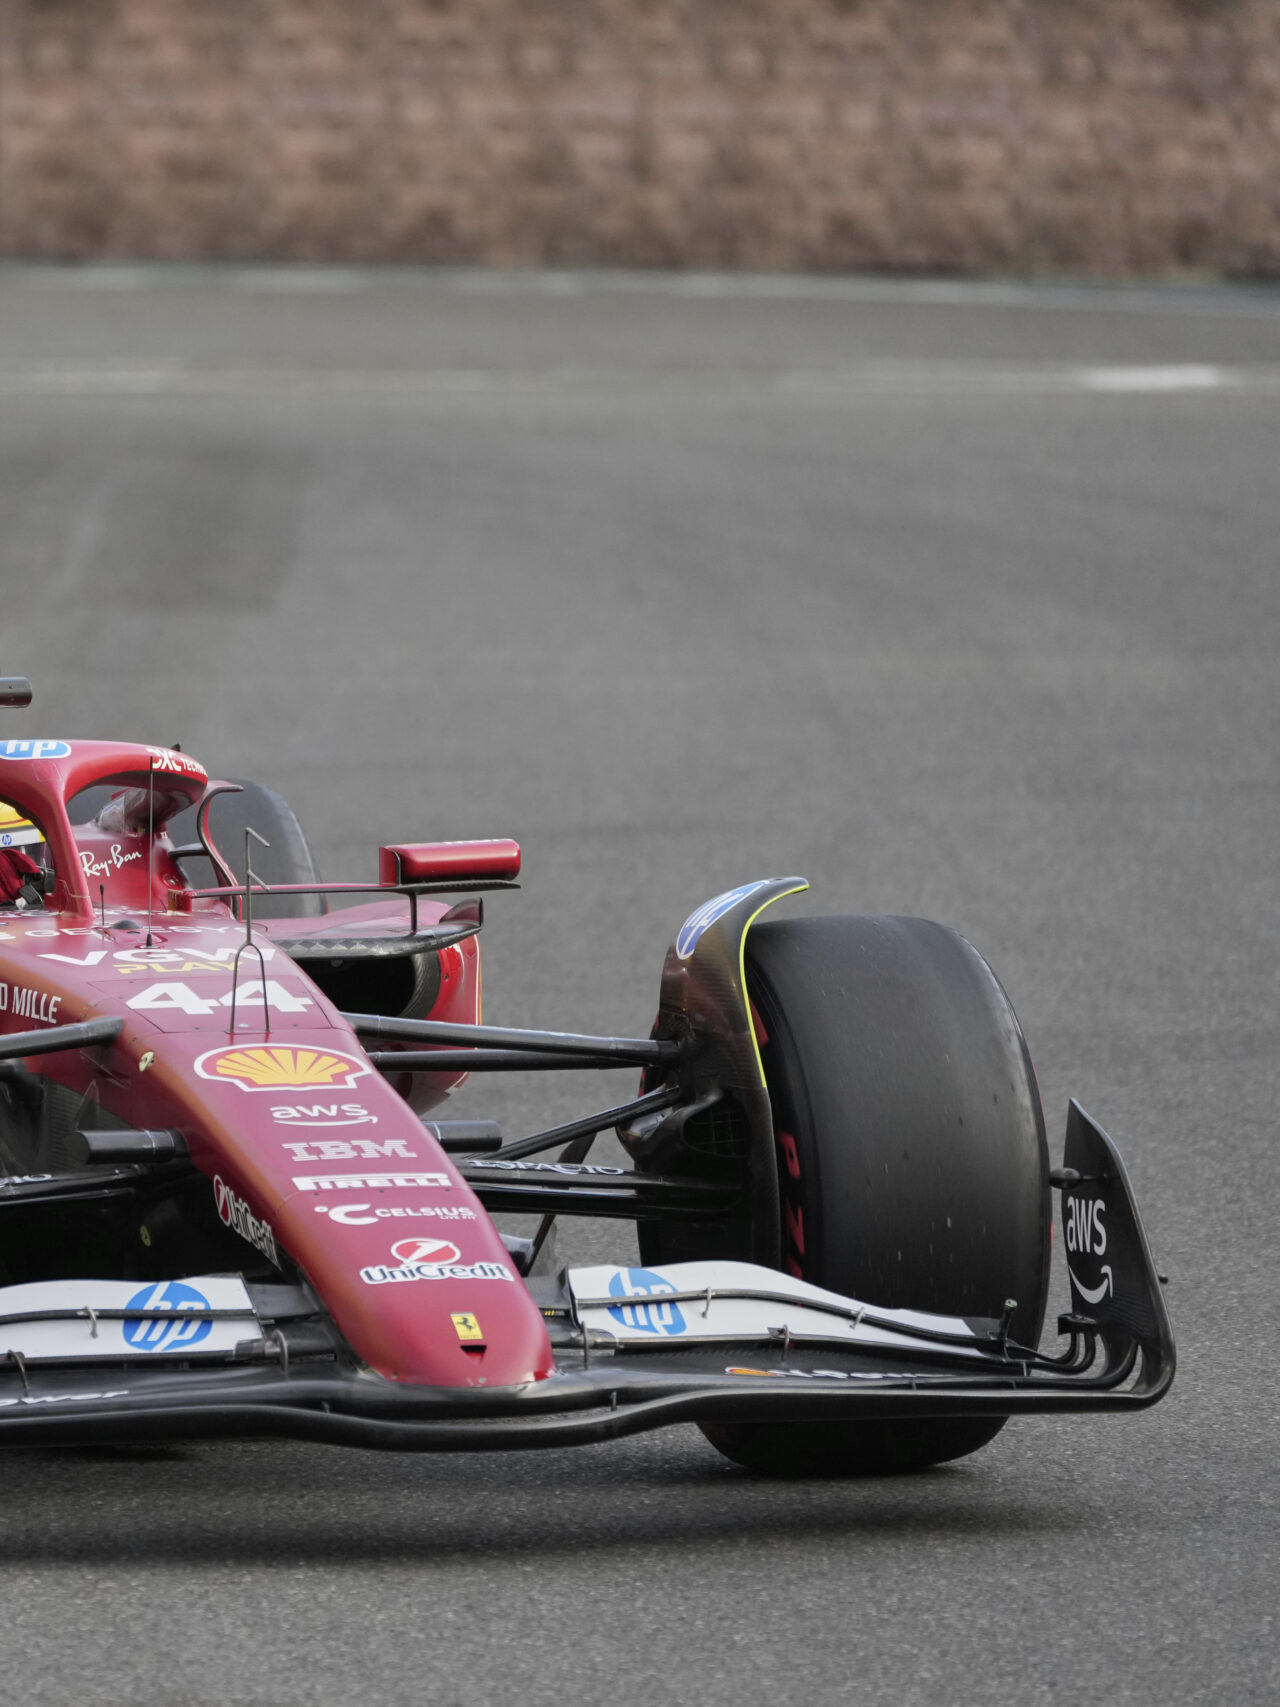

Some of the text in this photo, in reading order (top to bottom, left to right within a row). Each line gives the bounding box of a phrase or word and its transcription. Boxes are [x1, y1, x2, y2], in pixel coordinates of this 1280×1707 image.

[80, 844, 142, 877] Ray-Ban
[36, 948, 276, 966] VGW
[112, 961, 244, 974] PLAY
[11, 985, 62, 1024] MILLE
[125, 980, 313, 1015] 44
[270, 1104, 369, 1119] aws
[282, 1139, 418, 1162] IBM
[291, 1172, 453, 1191] PIRELLI
[375, 1207, 474, 1218] CELSIUS
[1066, 1196, 1108, 1256] aws
[362, 1262, 513, 1284] UniCredit
[617, 1267, 677, 1335] hp
[129, 1281, 207, 1353] hp
